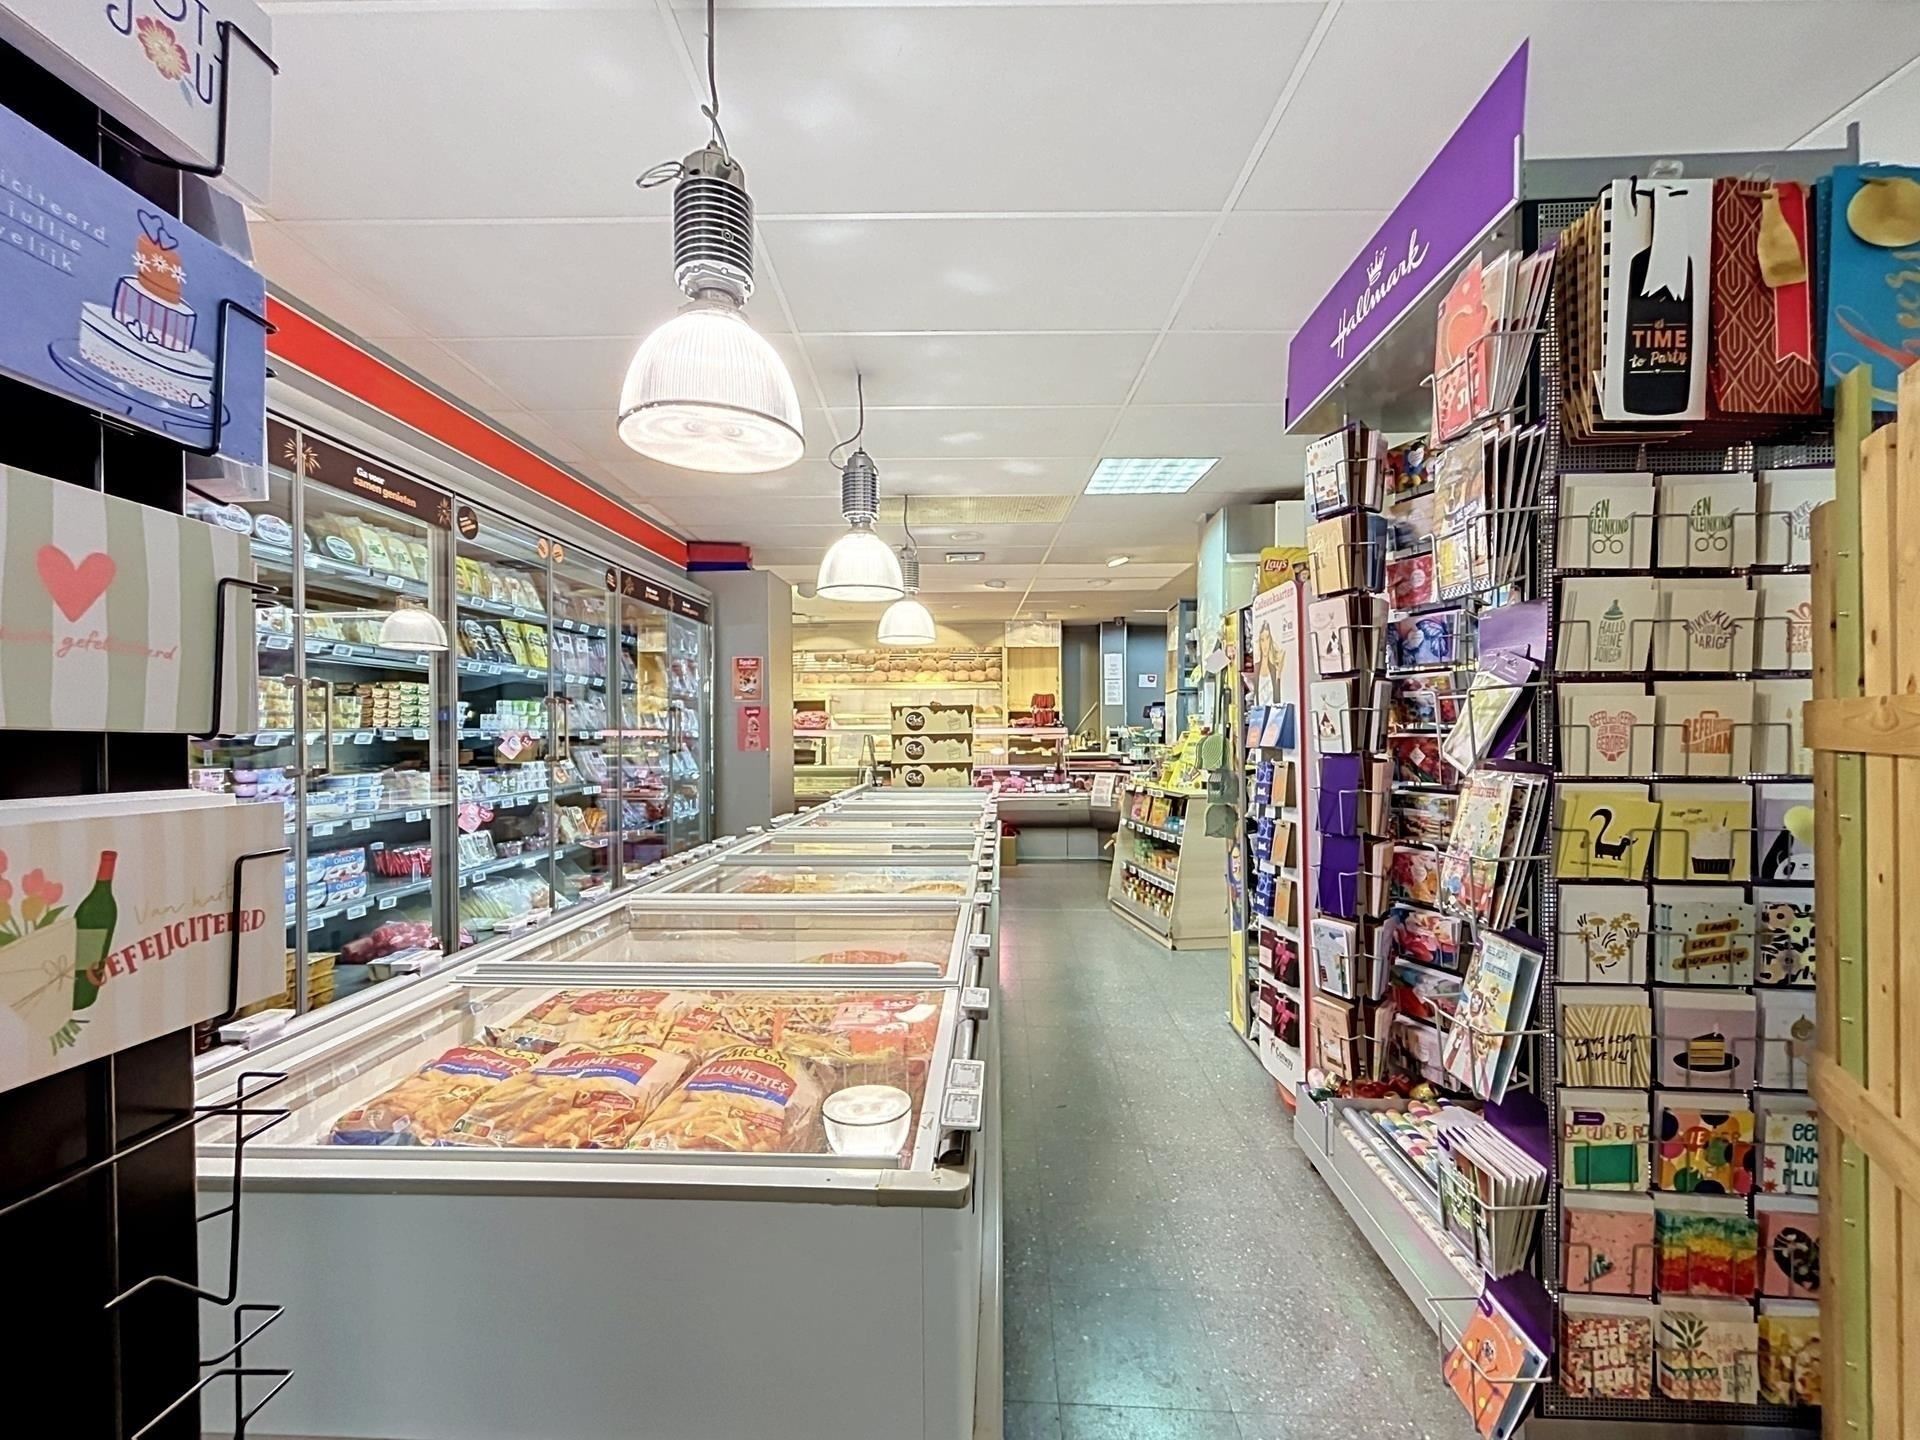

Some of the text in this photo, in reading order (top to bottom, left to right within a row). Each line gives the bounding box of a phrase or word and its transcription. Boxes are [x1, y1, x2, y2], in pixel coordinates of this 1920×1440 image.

[1329, 228, 1430, 359] Hallmark
[1631, 329, 1688, 349] TIME
[1628, 349, 1688, 368] to Party
[334, 855, 357, 866] OIKOS
[335, 879, 358, 891] OIKOS
[717, 1046, 788, 1070] McCain
[698, 1064, 791, 1092] ALLUMETTES
